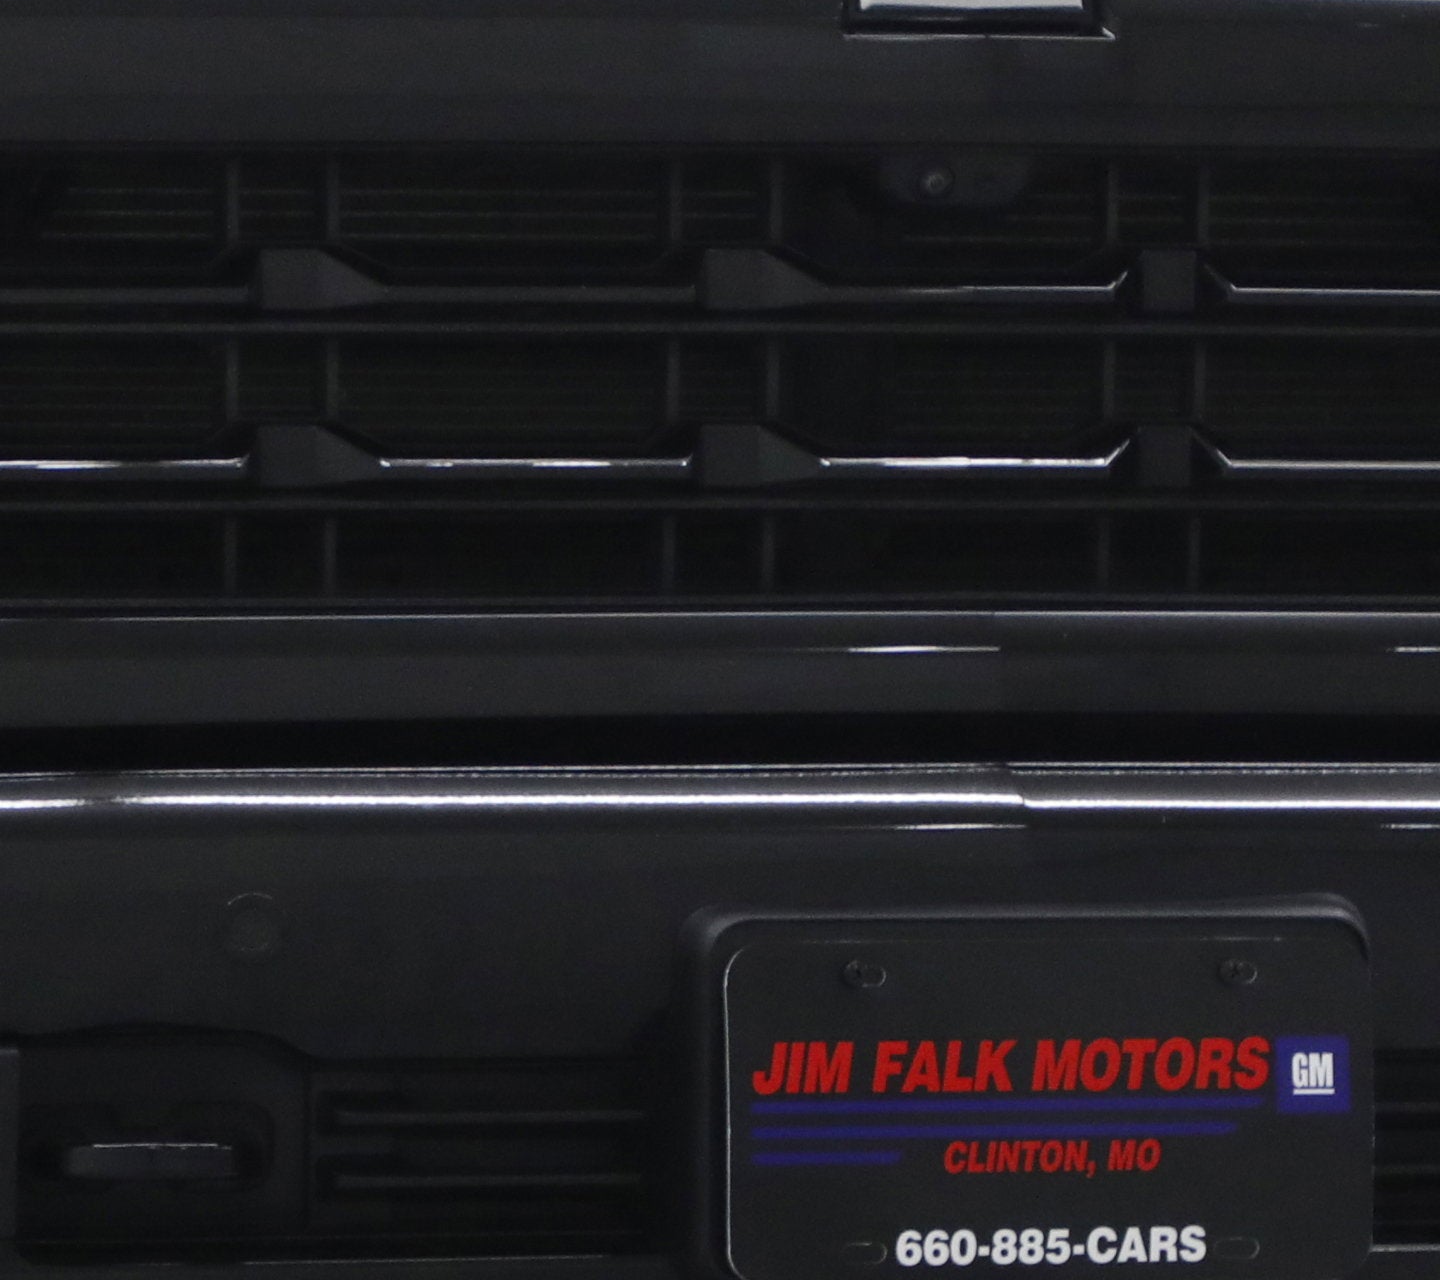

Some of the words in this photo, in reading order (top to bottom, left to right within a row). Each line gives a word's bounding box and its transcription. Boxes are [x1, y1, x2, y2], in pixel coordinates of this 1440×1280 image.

[751, 1040, 855, 1095] JIM
[871, 1039, 1017, 1093] FALK
[1030, 1035, 1271, 1093] MOTORS
[1291, 1051, 1334, 1089] GM
[942, 1139, 1097, 1177] CLINTON,
[1106, 1138, 1162, 1172] MO
[894, 1224, 1208, 1267] 660-885-CARS
